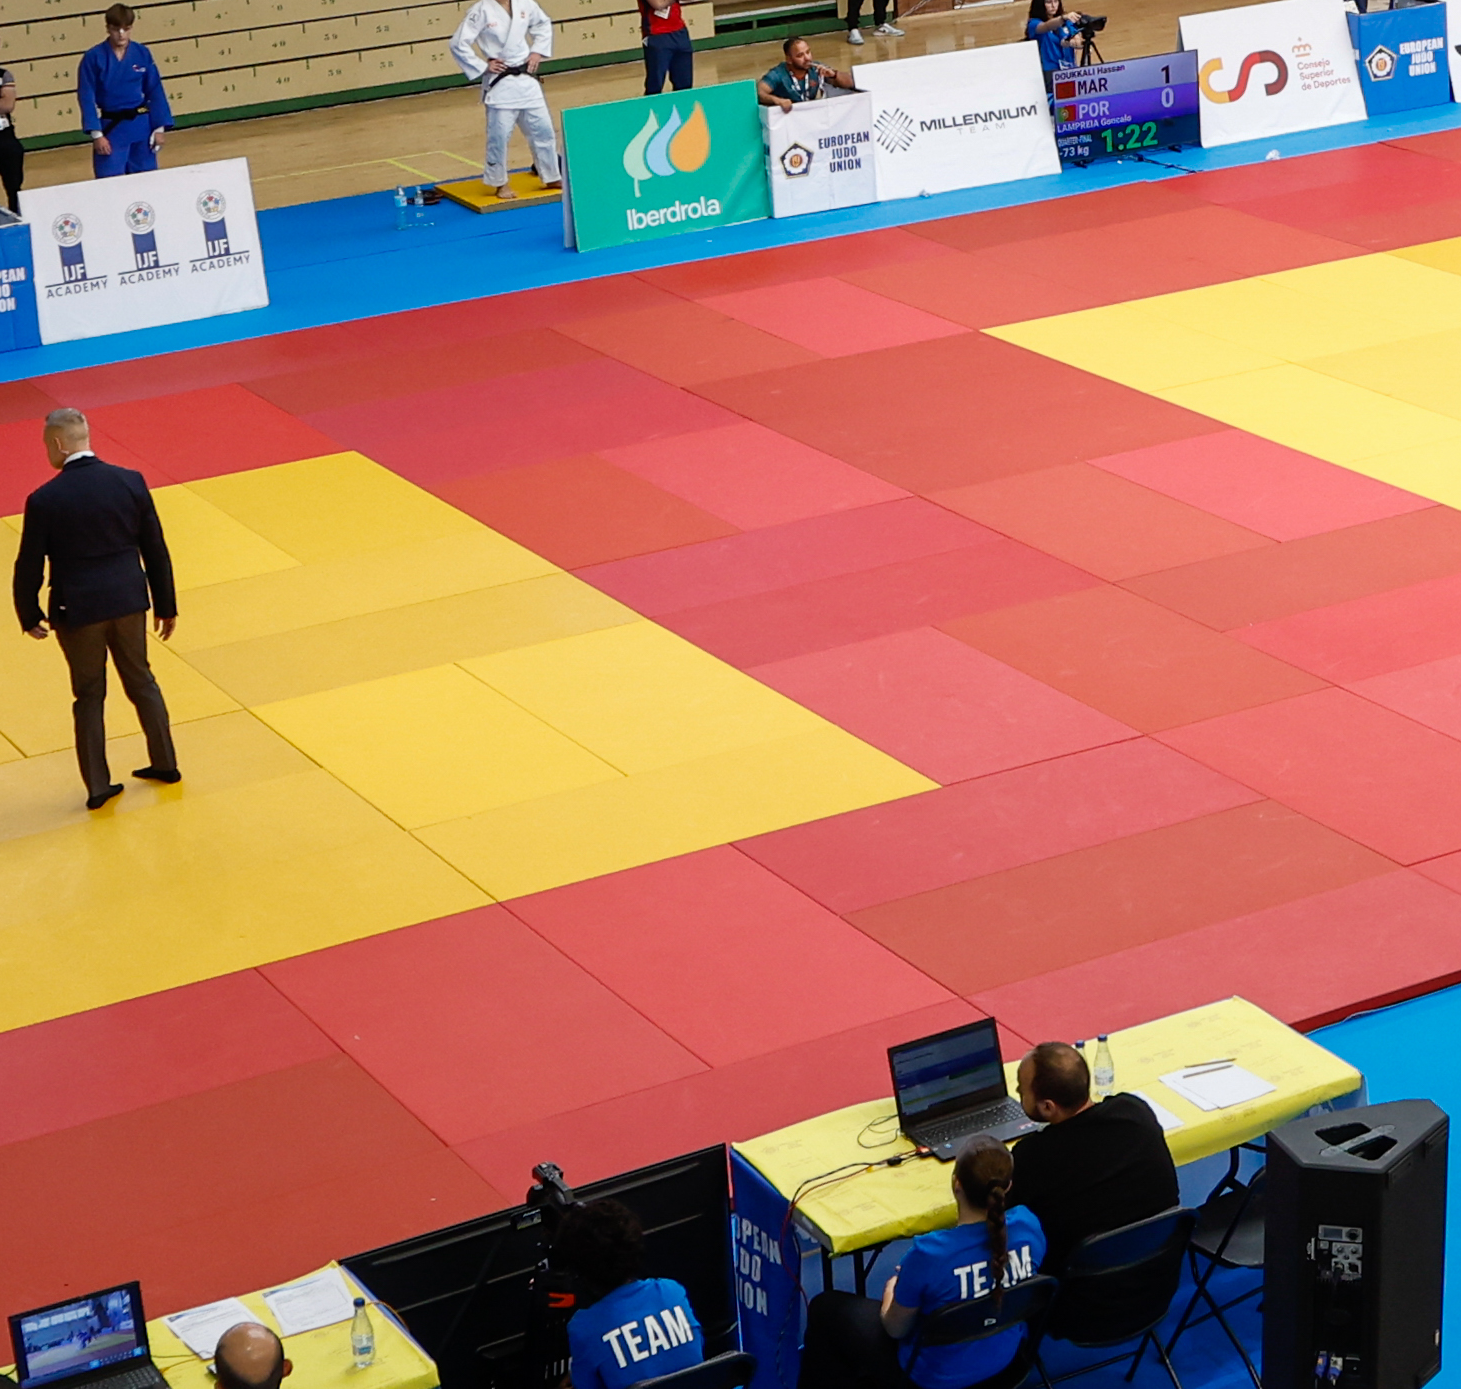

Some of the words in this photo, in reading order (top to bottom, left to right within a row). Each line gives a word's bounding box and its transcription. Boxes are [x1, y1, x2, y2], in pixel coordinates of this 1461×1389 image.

[1399, 36, 1444, 56] EUROPEAN
[1055, 69, 1095, 81] DOUKKALI
[1296, 57, 1331, 73] Consejo
[1078, 77, 1108, 95] MAR
[1161, 65, 1170, 83] 1
[1300, 68, 1335, 83] Superior
[1302, 80, 1312, 91] de
[1314, 75, 1351, 92] Deportes
[1079, 100, 1110, 119] POR
[1161, 87, 1174, 108] 0
[919, 105, 1037, 133] MILLENNIUM
[818, 130, 870, 150] EUROPEAN
[1077, 145, 1089, 156] kg
[1101, 121, 1158, 153] 1:22
[831, 145, 858, 161] JUDO
[829, 157, 862, 175] UNION
[627, 196, 720, 231] Iberdrola
[208, 239, 229, 257] IJF
[137, 252, 158, 269] IJF
[190, 253, 251, 274] ACADEMY
[63, 264, 85, 282] IJF
[119, 266, 180, 286] ACADEMY
[46, 278, 108, 299] ACADEMY
[602, 1305, 694, 1369] TEAM
